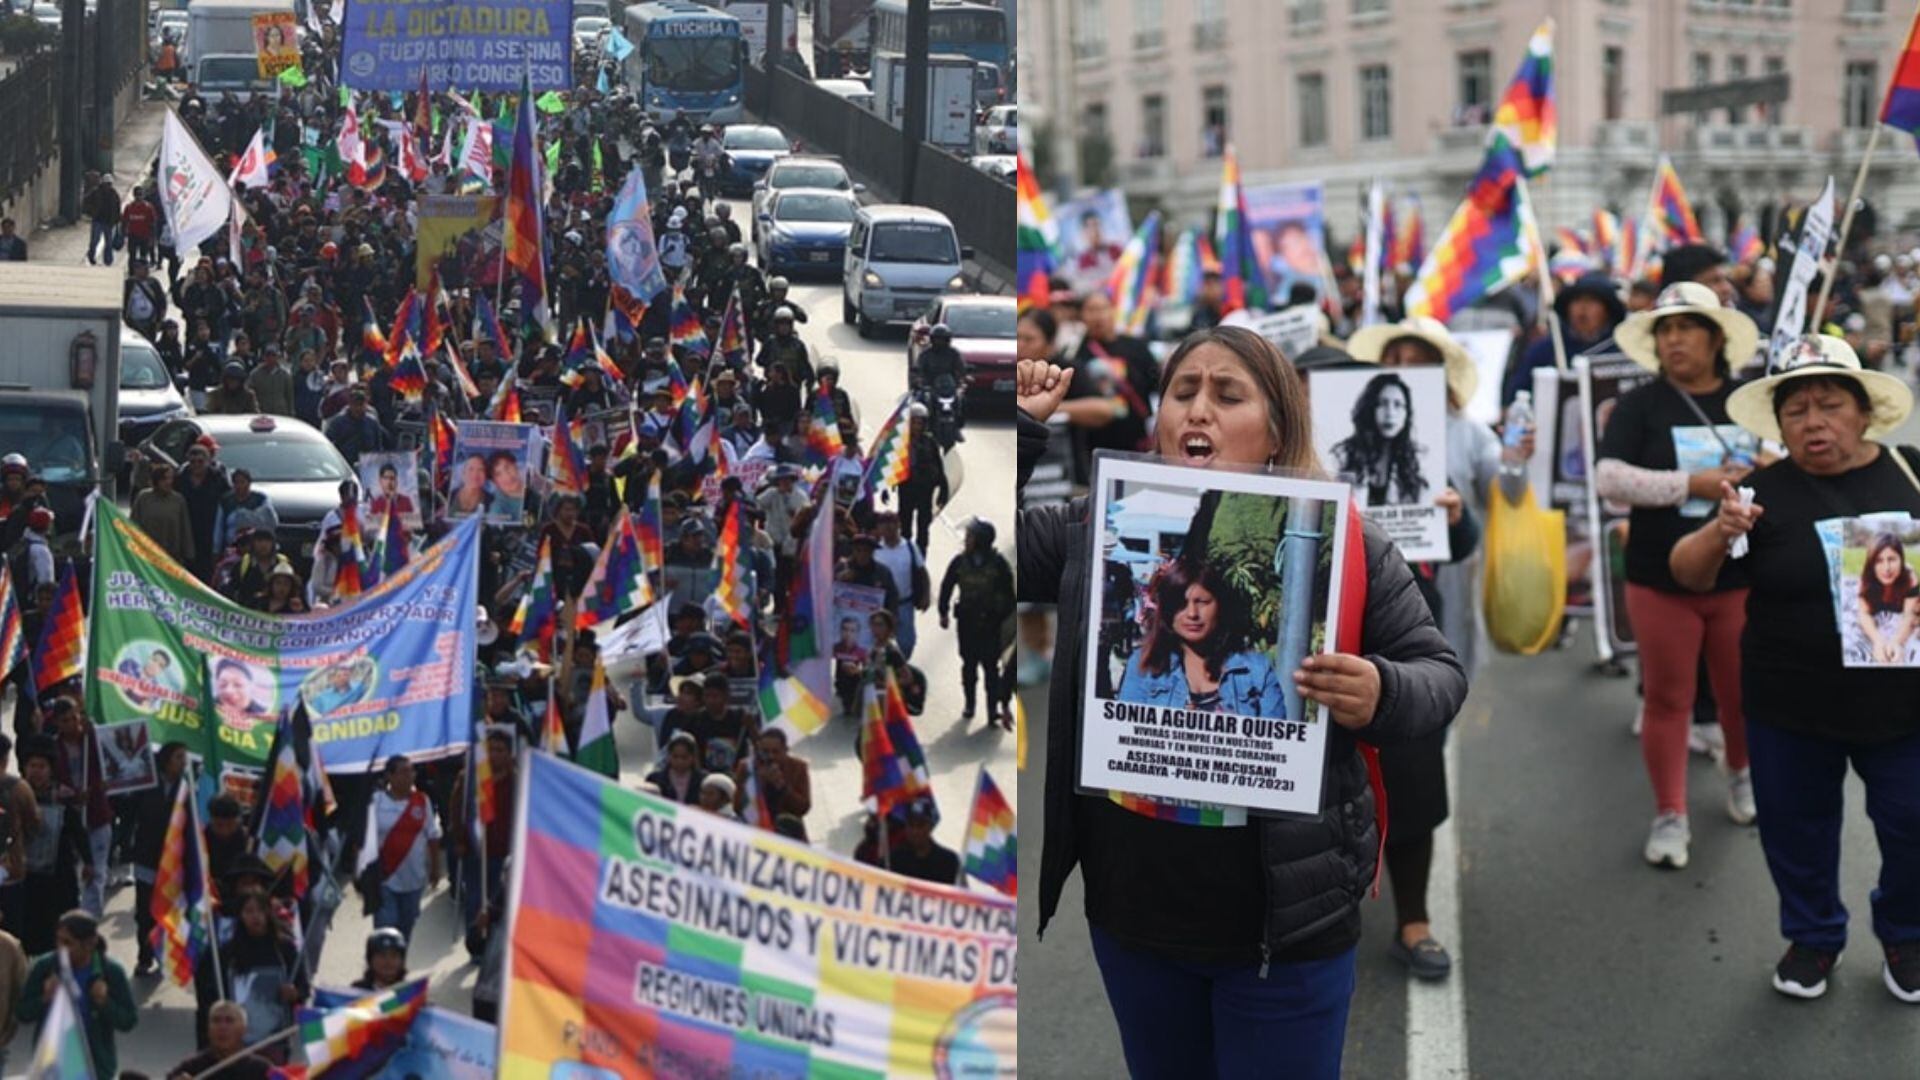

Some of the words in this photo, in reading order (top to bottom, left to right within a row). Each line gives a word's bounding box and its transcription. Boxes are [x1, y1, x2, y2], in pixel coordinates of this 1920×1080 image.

[366, 12, 397, 38] LA
[408, 7, 550, 37] DICTADURA
[157, 702, 257, 750] JUSCIA
[312, 710, 400, 743] GNIDAD
[1104, 701, 1157, 725] SONIA
[1161, 708, 1238, 735] AGUILAR
[1242, 717, 1308, 742] QUISPE
[1118, 736, 1166, 750] MEMORIAS
[1167, 741, 1174, 751] Y
[1174, 742, 1187, 752] EN
[1187, 744, 1234, 758] NUESTROS
[1235, 749, 1287, 764] CORAZONES
[1172, 730, 1211, 744] SIEMPRE
[1213, 735, 1225, 746] EN
[1226, 737, 1273, 751] NUESTROS
[1107, 759, 1169, 777] CARABAYA
[1126, 750, 1193, 769] ASESINADA
[1195, 758, 1210, 770] EN
[1212, 760, 1278, 778] MACUSANI
[635, 814, 862, 911] ORGANIZACION
[606, 862, 794, 951] ASESINADOS
[804, 914, 823, 955] Y
[834, 921, 979, 983] VICTIMAS
[637, 965, 749, 1028] REGIONES
[756, 1009, 836, 1048] UNIDAS
